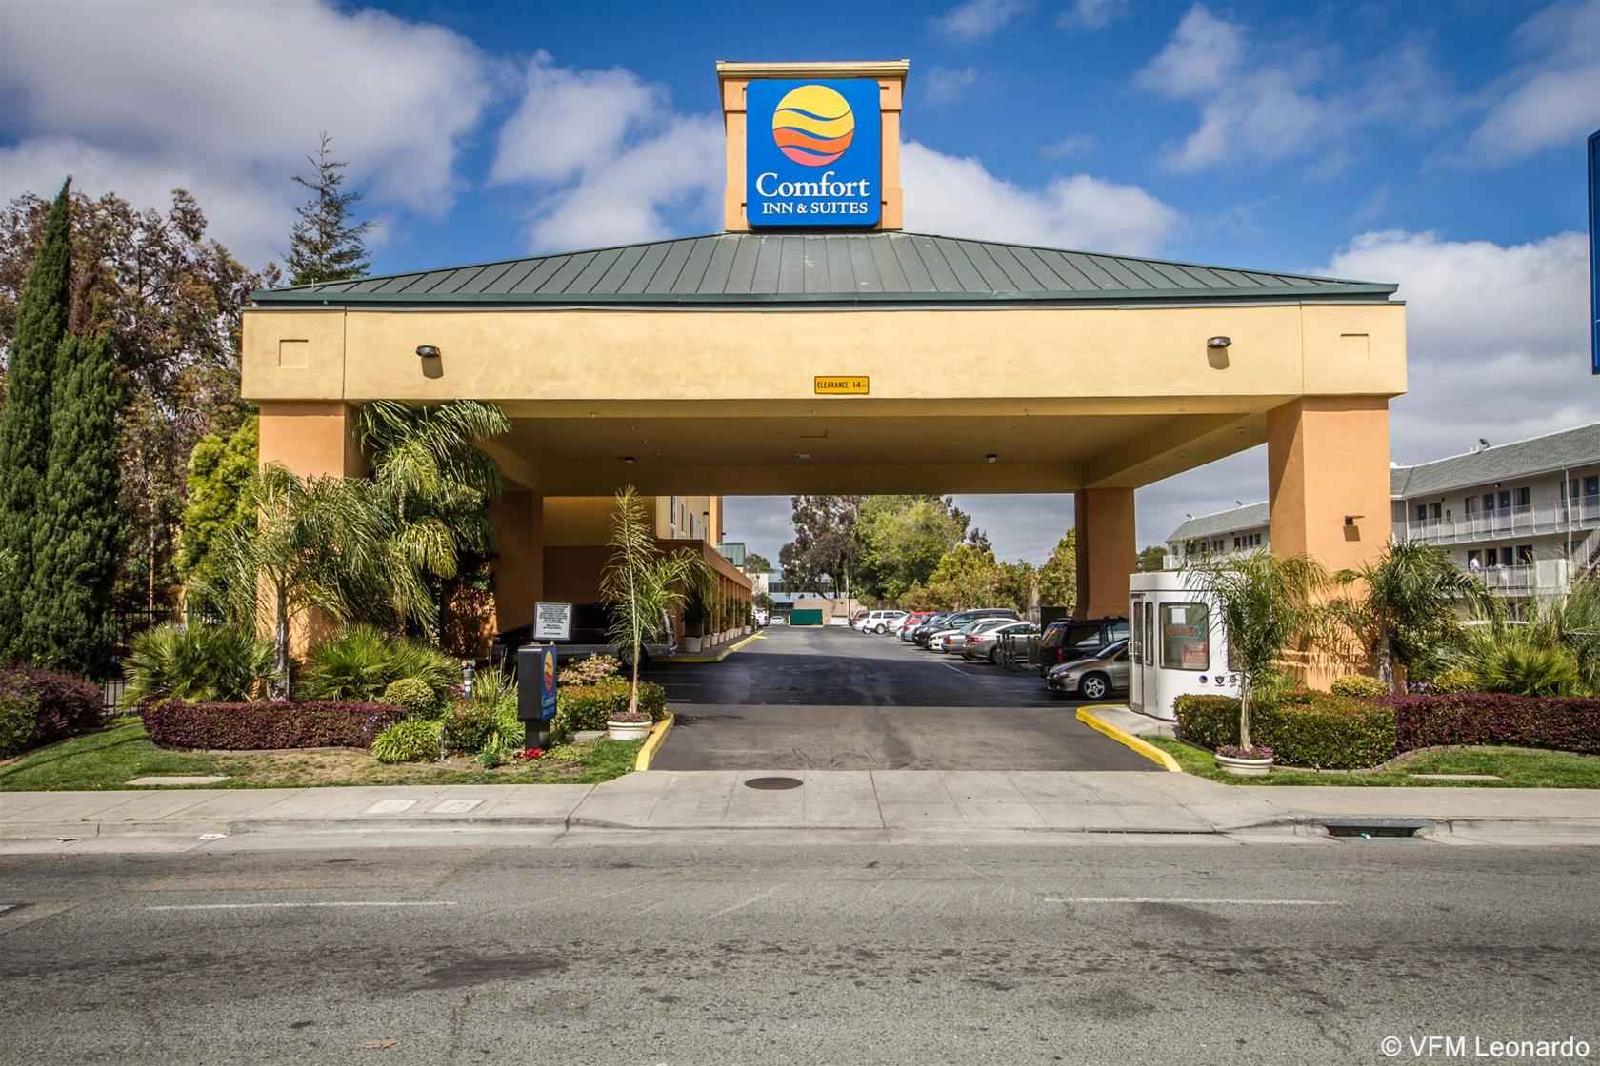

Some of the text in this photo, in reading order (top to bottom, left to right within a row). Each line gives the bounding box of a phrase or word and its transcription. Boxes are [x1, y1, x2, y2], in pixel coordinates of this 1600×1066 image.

[756, 171, 870, 197] Comfort
[762, 202, 868, 214] INN & SUITES
[816, 381, 849, 389] CLEARANCE
